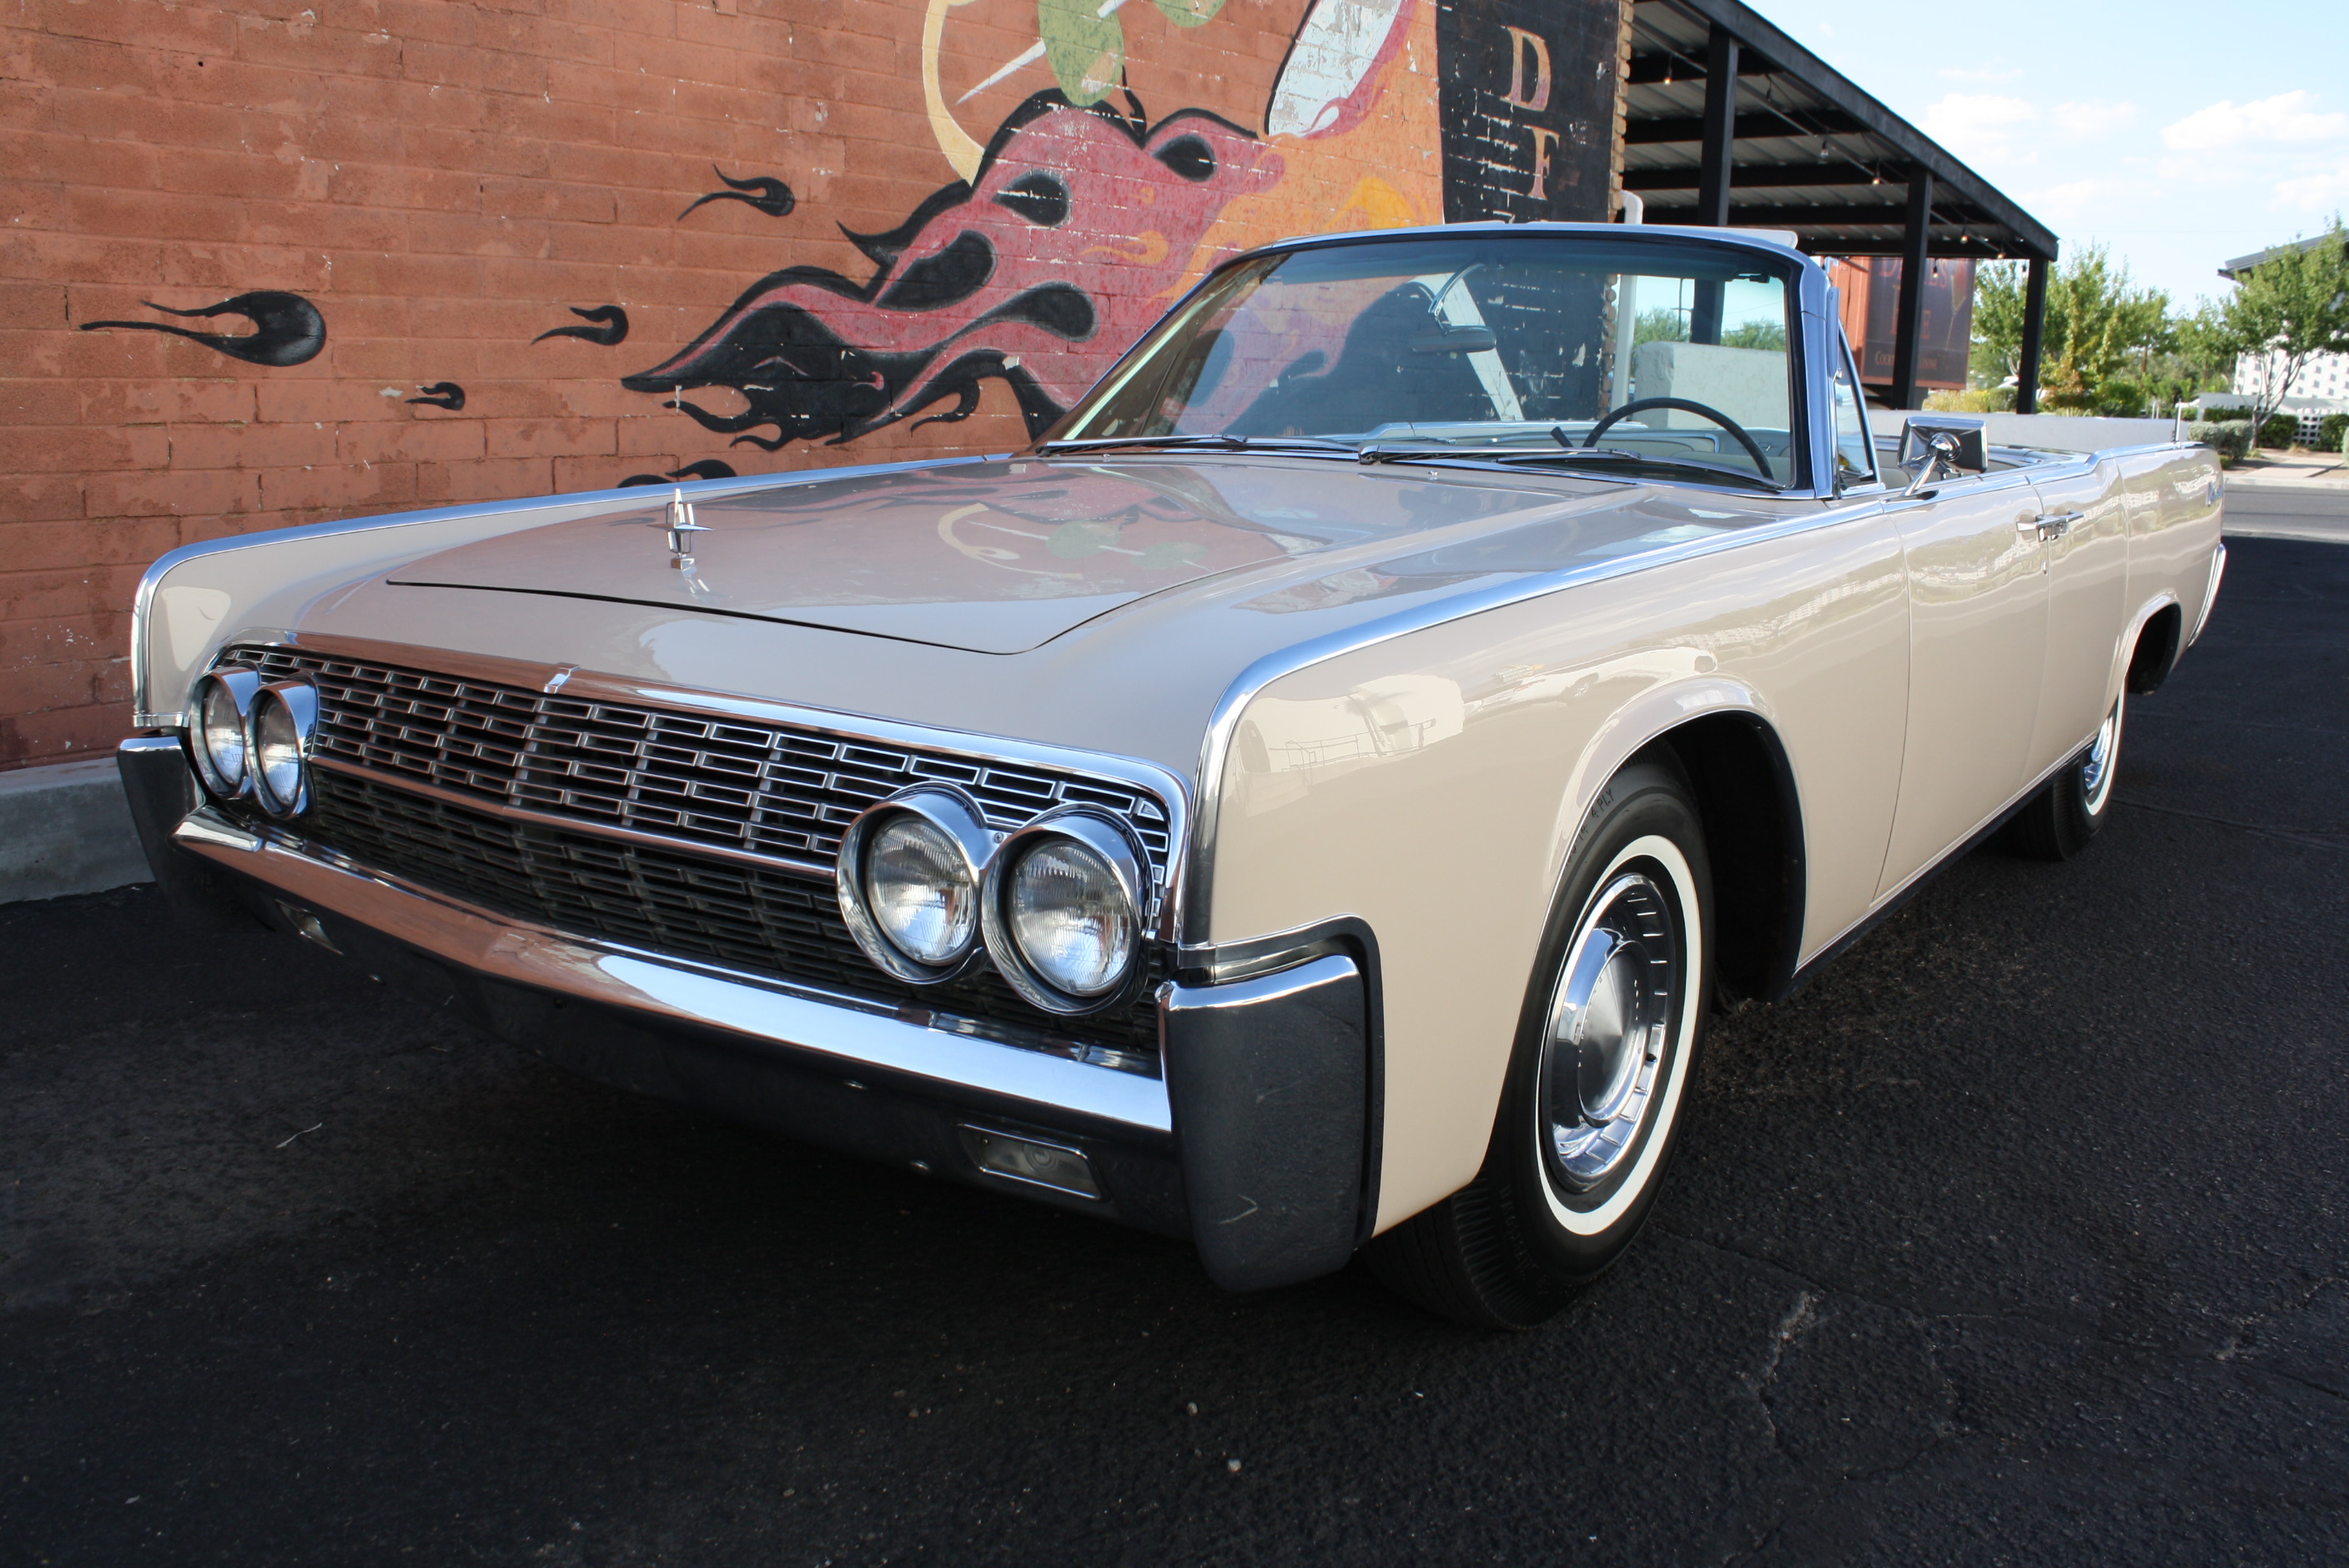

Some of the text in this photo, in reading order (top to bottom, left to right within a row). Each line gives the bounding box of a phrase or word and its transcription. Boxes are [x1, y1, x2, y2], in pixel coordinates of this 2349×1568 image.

[1500, 26, 1552, 112] D
[1522, 124, 1561, 200] F
[1597, 788, 1614, 812] PLY
